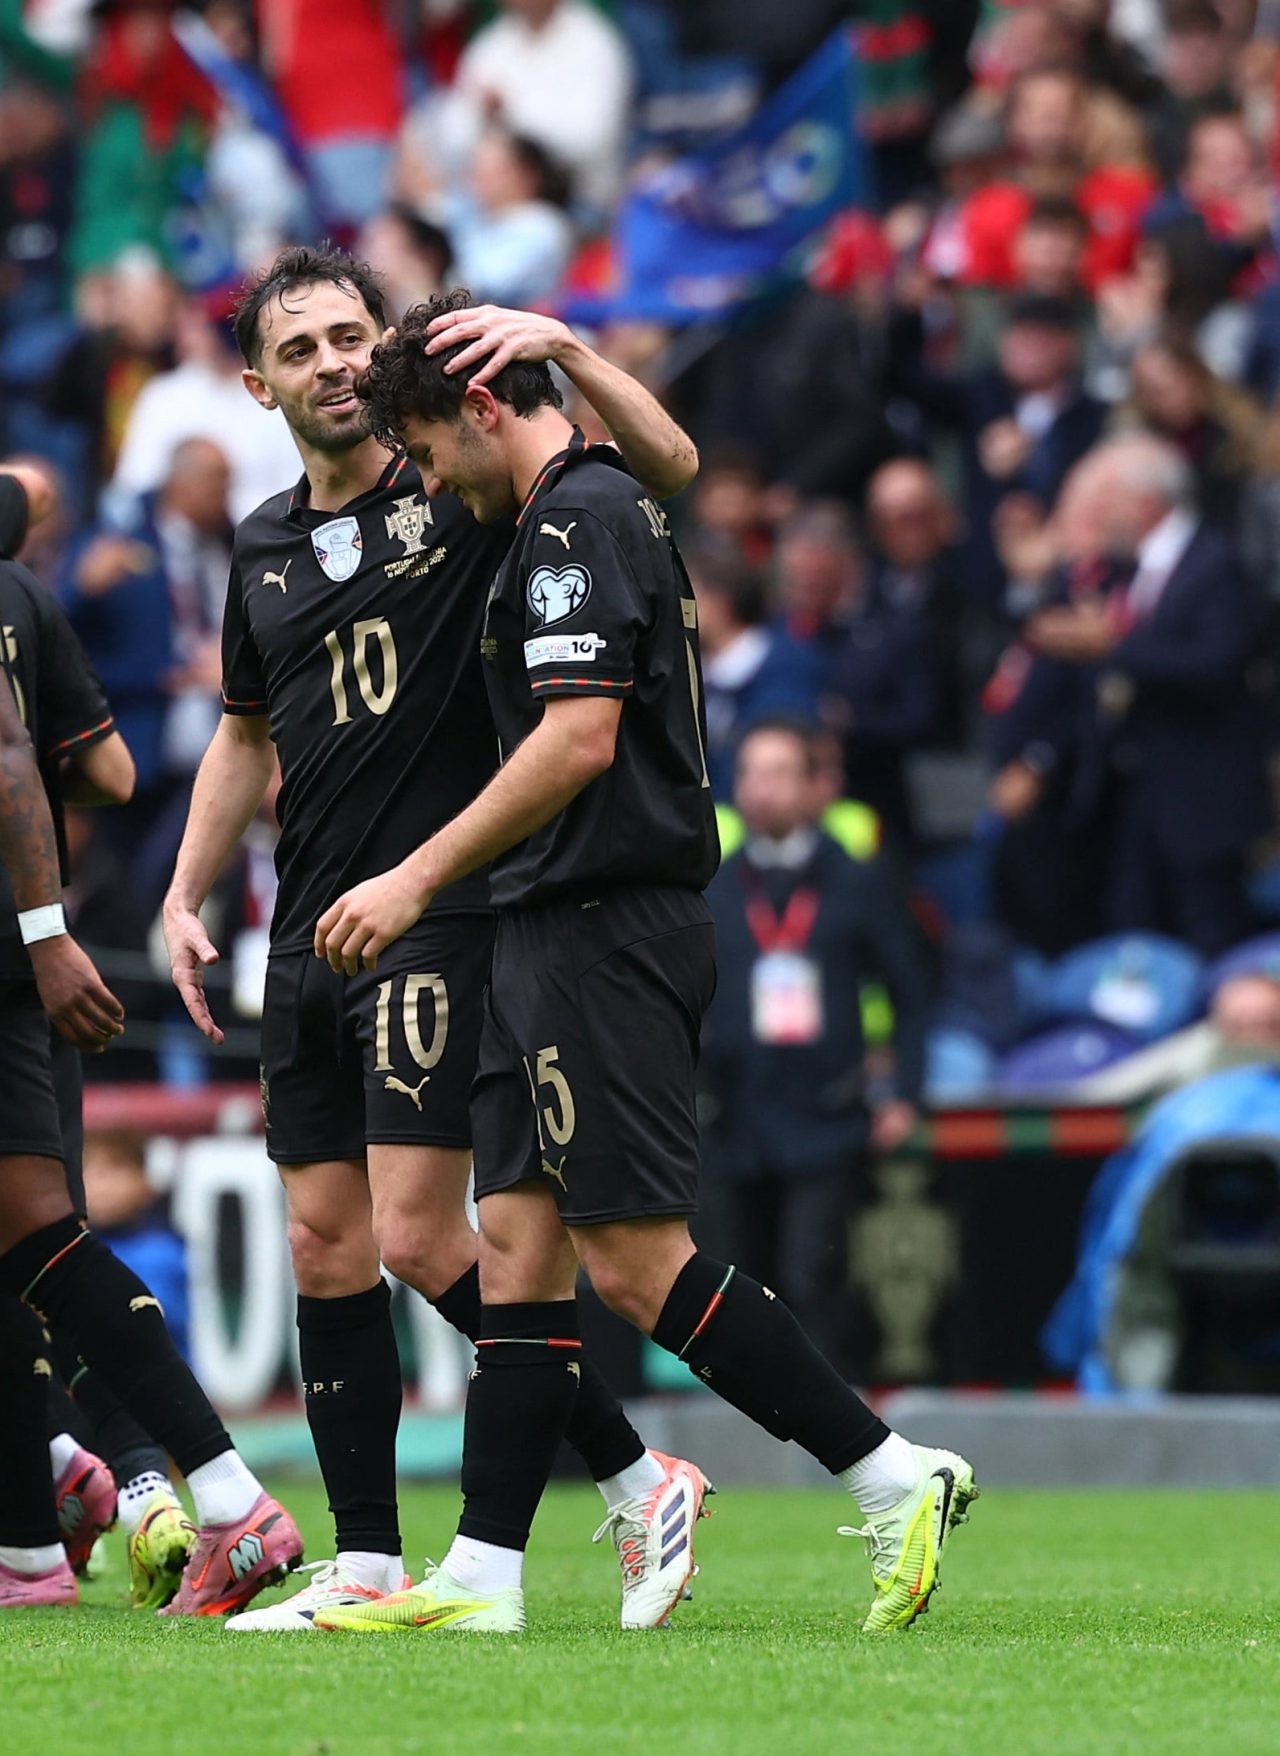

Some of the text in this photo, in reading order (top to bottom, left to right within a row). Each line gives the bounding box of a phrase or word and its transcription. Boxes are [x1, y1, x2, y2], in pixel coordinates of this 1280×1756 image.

[324, 616, 398, 727] 10
[571, 641, 592, 653] 10
[373, 973, 449, 1071] 10
